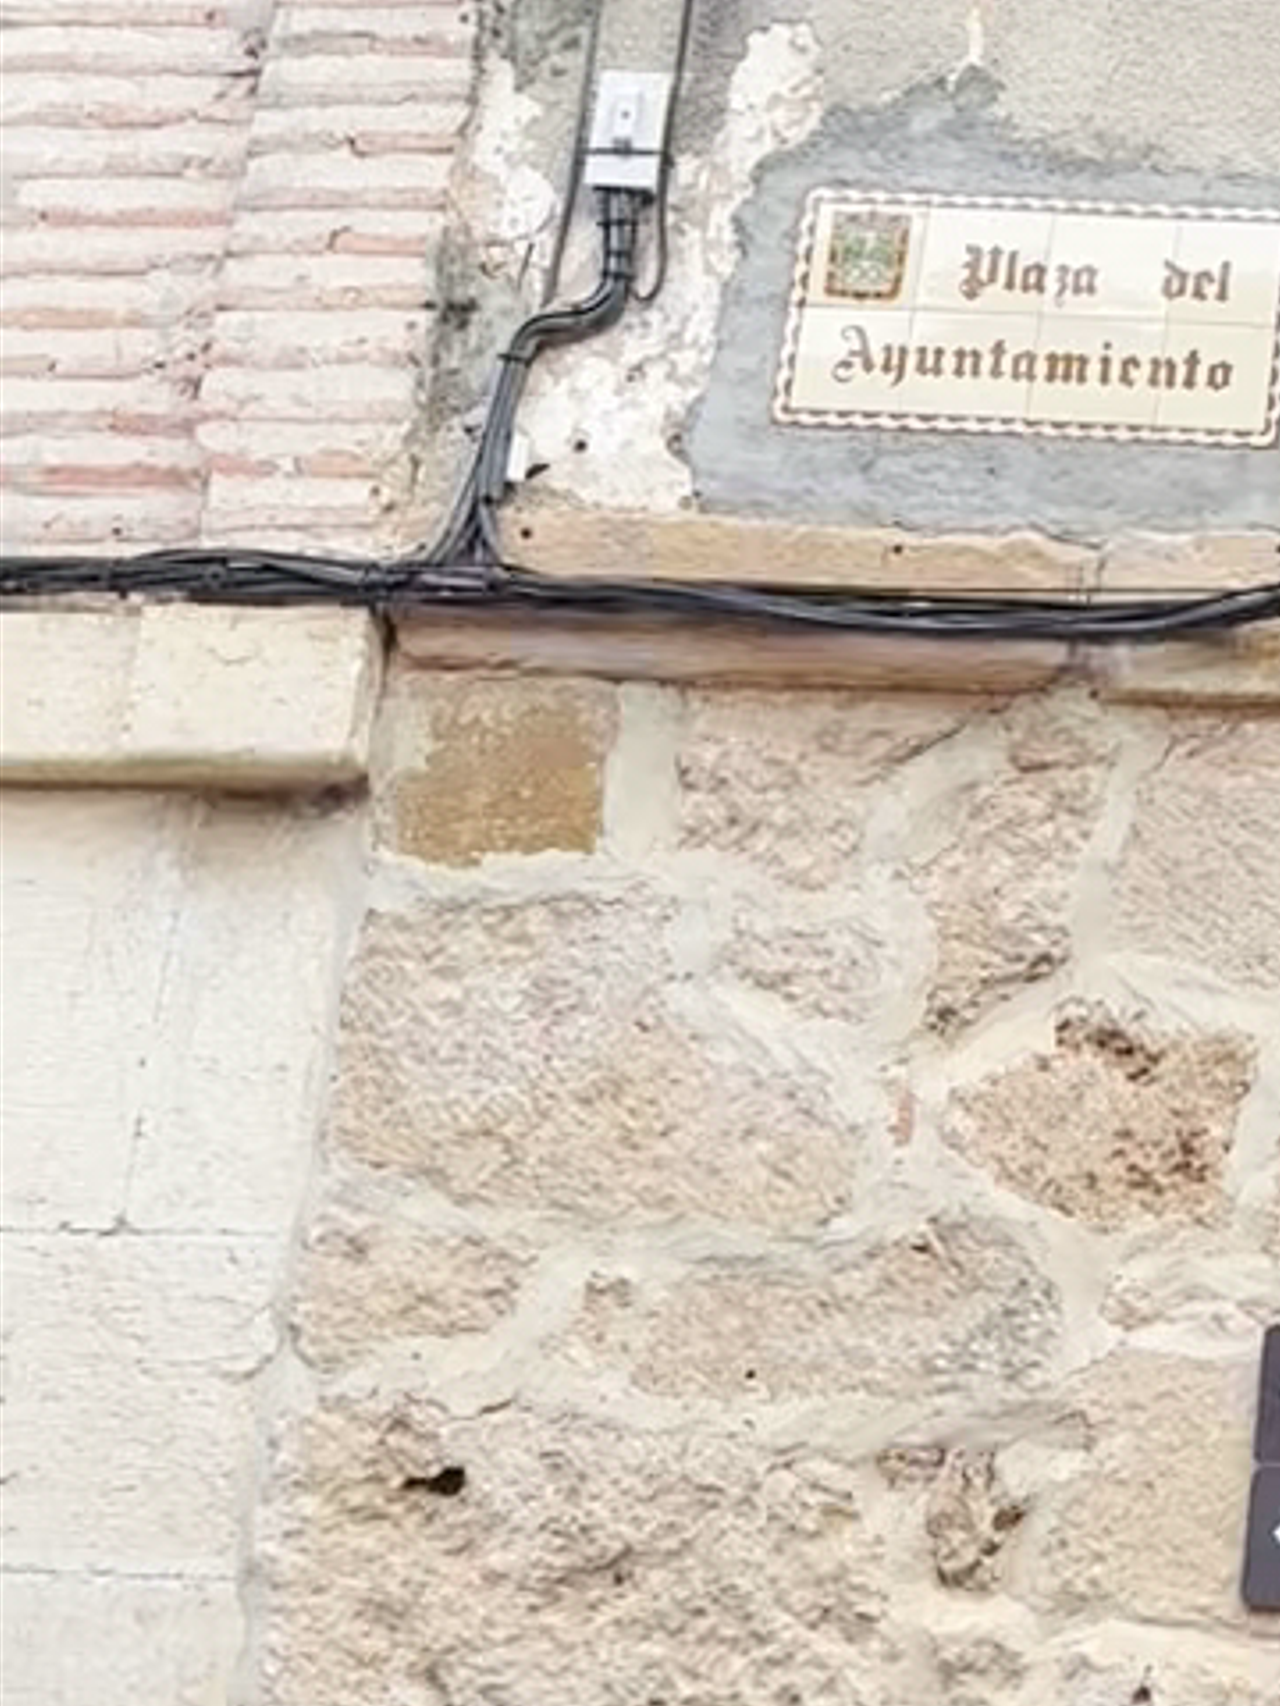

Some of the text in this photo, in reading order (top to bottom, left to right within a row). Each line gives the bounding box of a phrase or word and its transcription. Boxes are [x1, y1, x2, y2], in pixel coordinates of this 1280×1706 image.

[960, 242, 1231, 308] Plaza del
[831, 324, 1236, 393] Ayuntamiento
